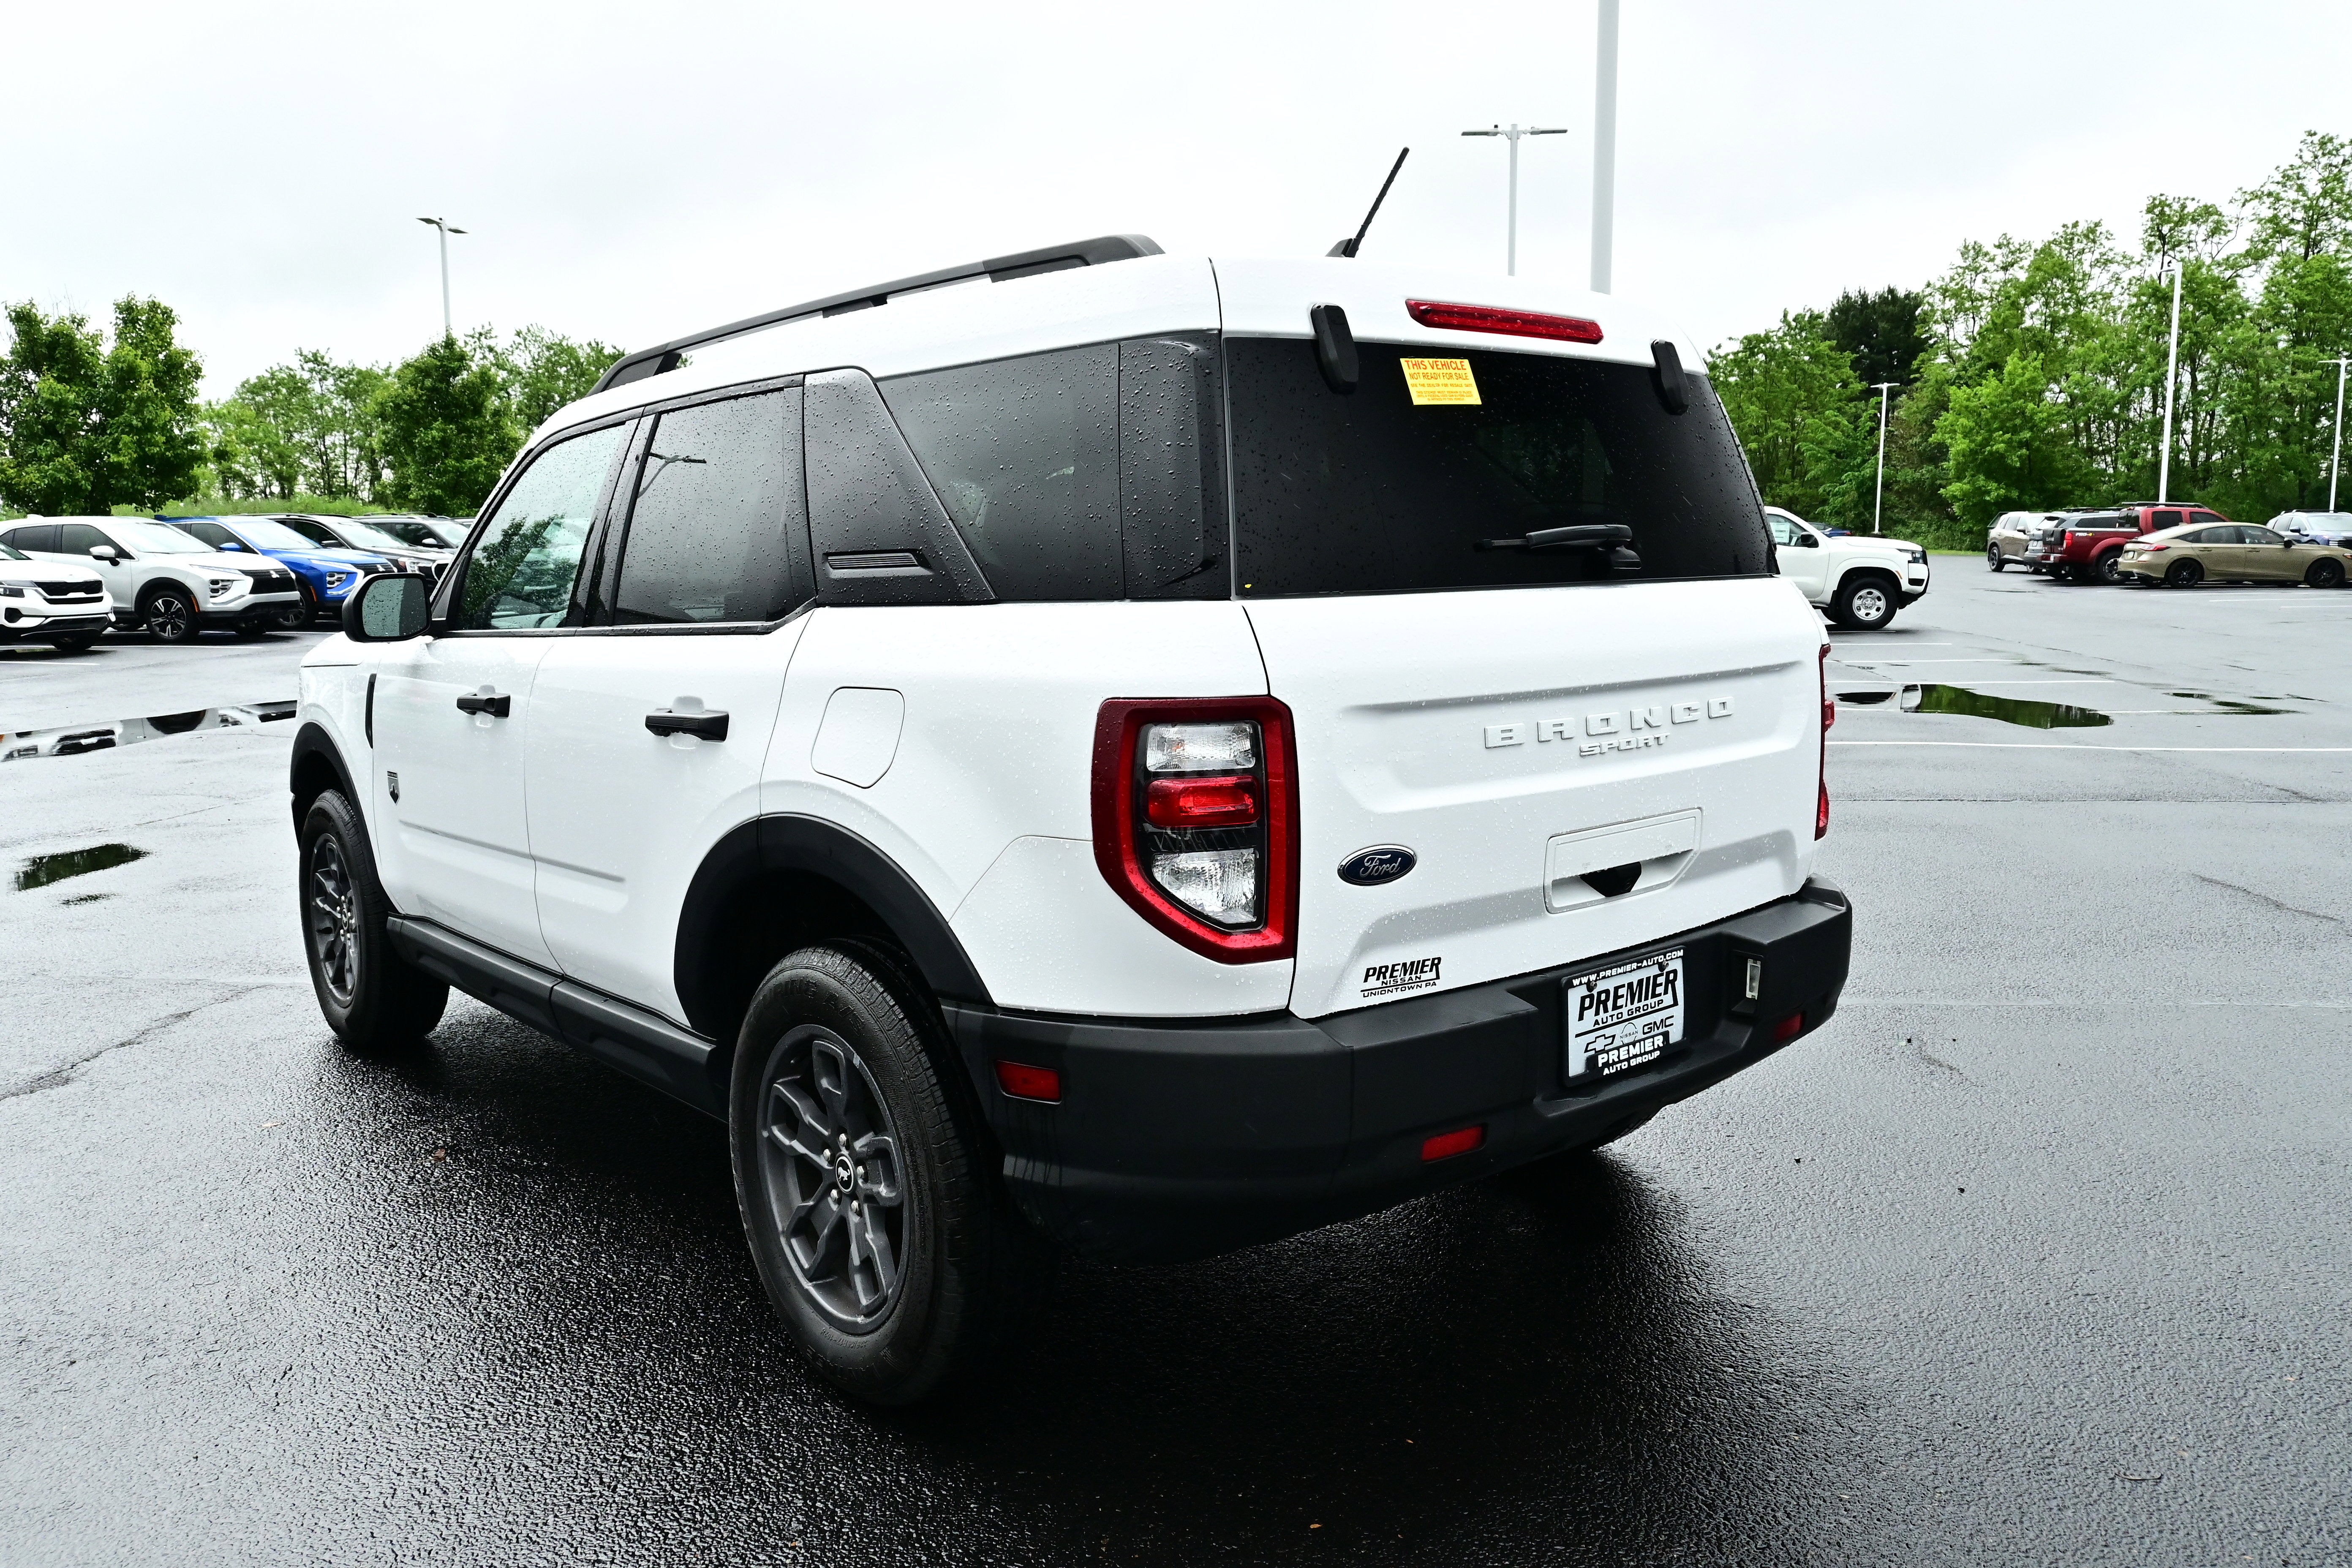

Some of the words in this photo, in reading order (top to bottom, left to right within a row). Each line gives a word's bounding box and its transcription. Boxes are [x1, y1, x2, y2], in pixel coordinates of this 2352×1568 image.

[1405, 360, 1427, 370] THIS
[1428, 360, 1467, 370] VEHICLE
[1484, 696, 1734, 749] BRONCO
[1579, 732, 1671, 757] SPORT
[1359, 854, 1402, 878] Ford
[1363, 957, 1442, 983] PREMIER
[1381, 975, 1422, 986] NISSAN
[1572, 950, 1684, 986] WWW.PREMIER-AUTO.COM
[1363, 984, 1423, 998] UNIONTOWN
[1578, 969, 1679, 1022] PREMIER
[1593, 1010, 1623, 1027] AUTO
[1627, 999, 1663, 1016] GROUP
[1620, 1030, 1639, 1040] NISSAN
[1642, 1015, 1674, 1036] GMC
[1598, 1035, 1663, 1067] PREMIER
[1603, 1061, 1628, 1075] AUTO
[1630, 1050, 1660, 1067] GROUP
